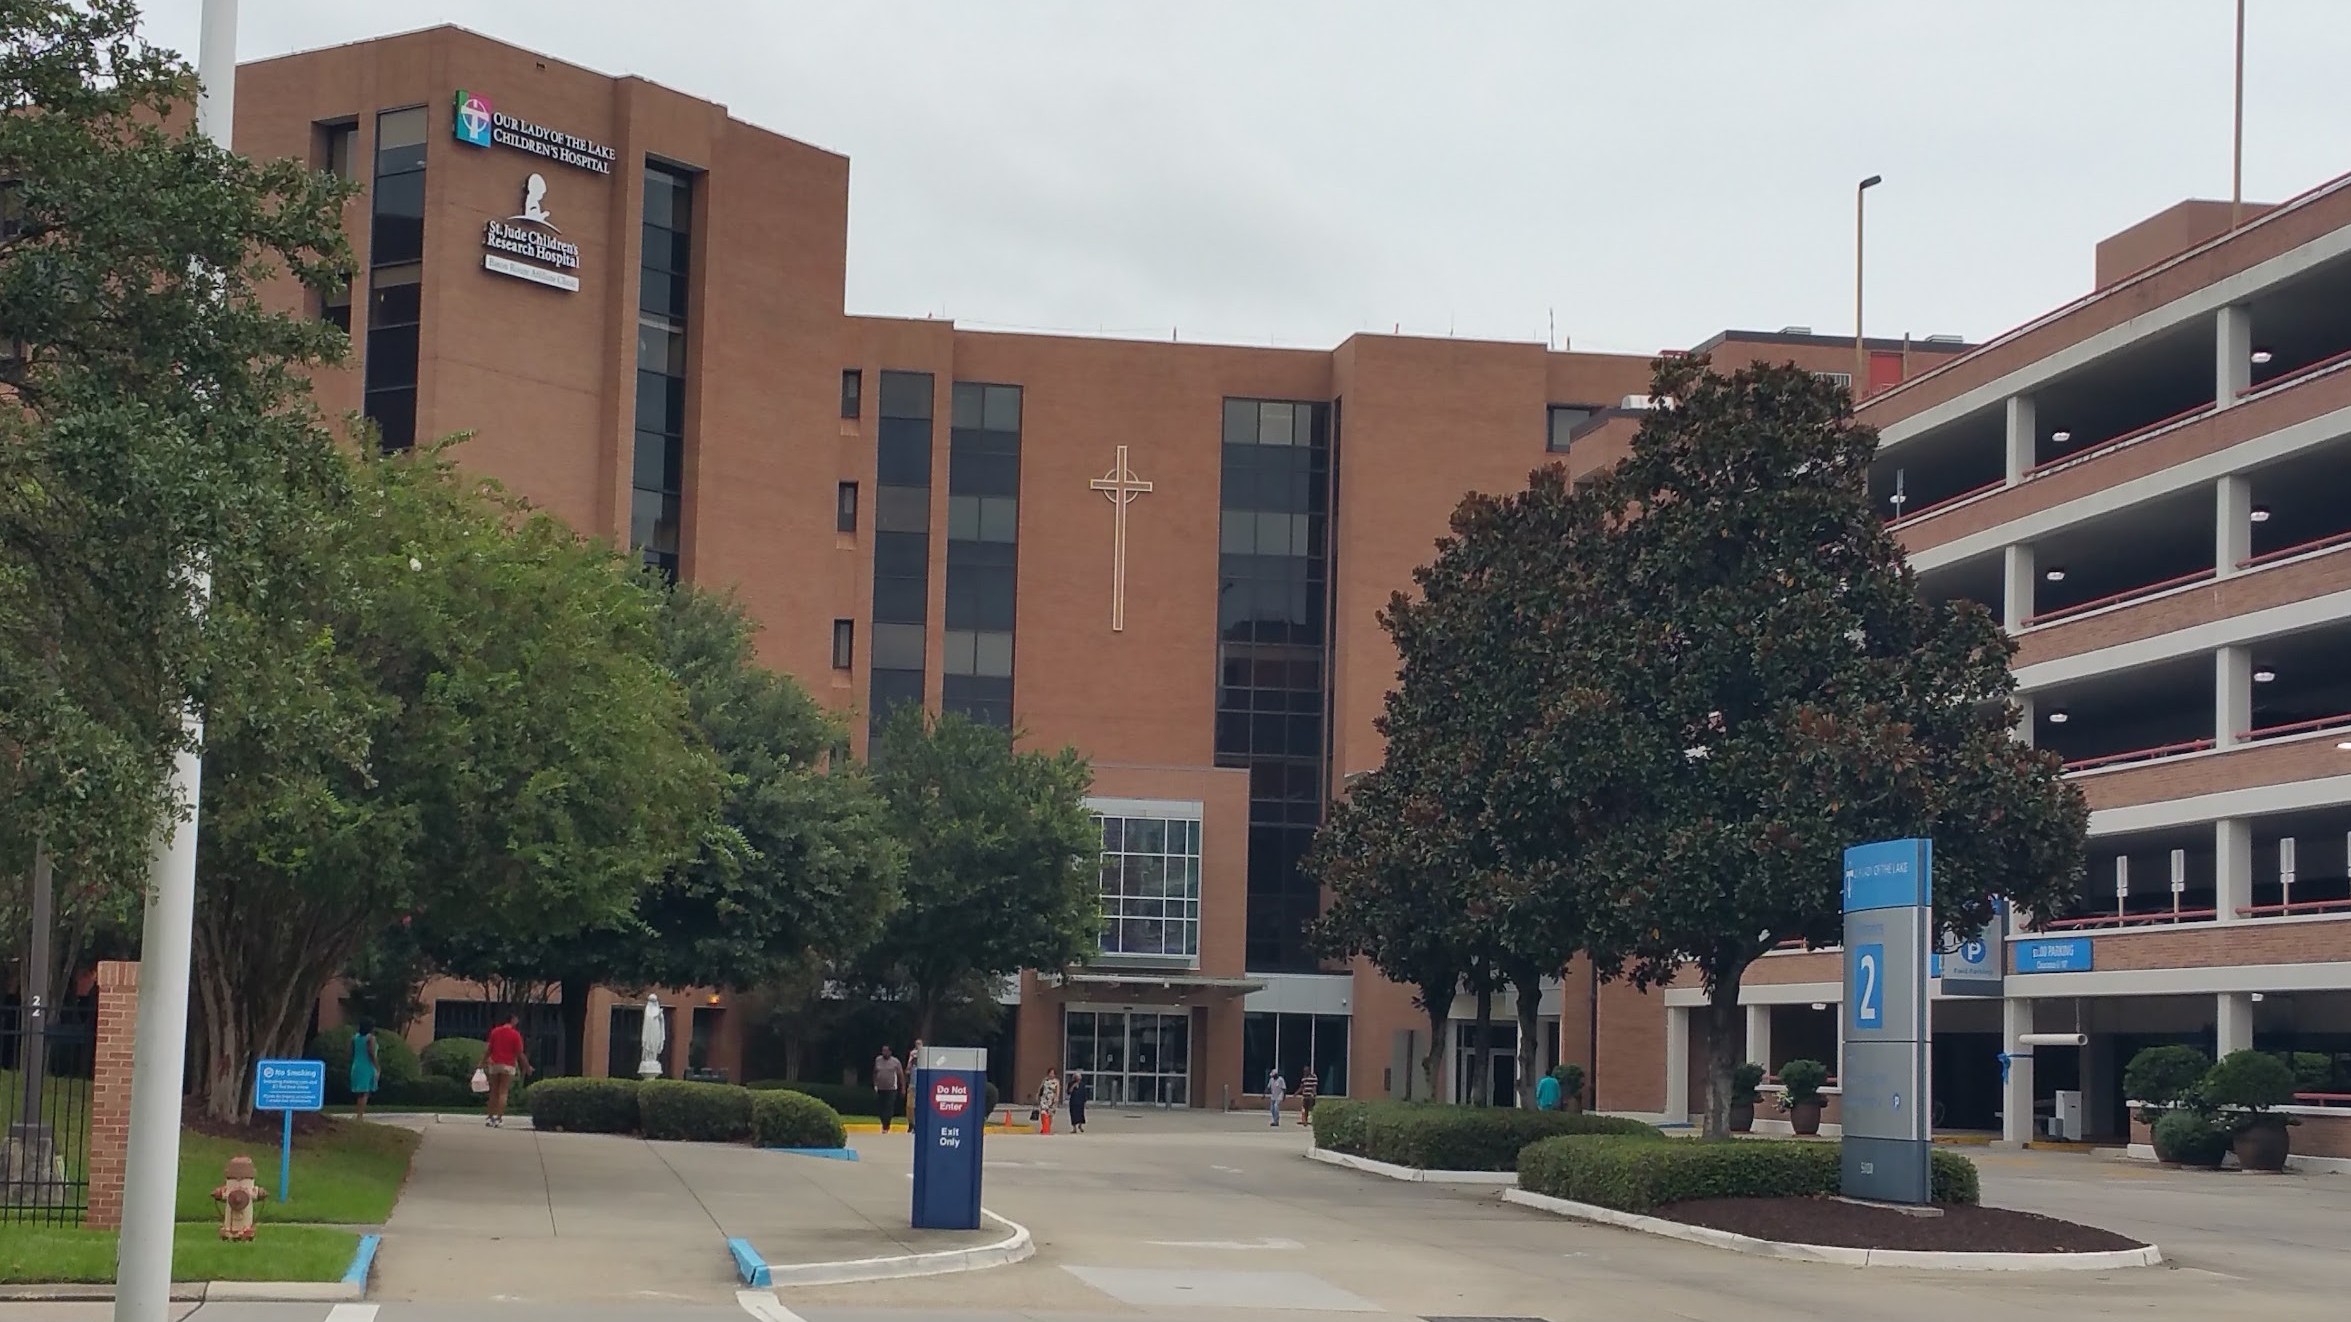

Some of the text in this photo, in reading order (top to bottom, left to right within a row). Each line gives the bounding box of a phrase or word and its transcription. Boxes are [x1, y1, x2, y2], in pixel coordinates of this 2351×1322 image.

[493, 112, 616, 160] OUR LADY OF THE LAKE
[493, 128, 610, 175] CHILDREN'S HOSPITAL
[487, 231, 580, 269] Research Hospital
[489, 220, 579, 256] St. Jude Children's
[1860, 954, 1876, 1020] 2
[274, 1069, 317, 1078] No Smoking
[936, 1085, 967, 1094] Do Not
[939, 1102, 963, 1111] Enter
[939, 1137, 960, 1149] Only
[941, 1127, 960, 1136] Exit
